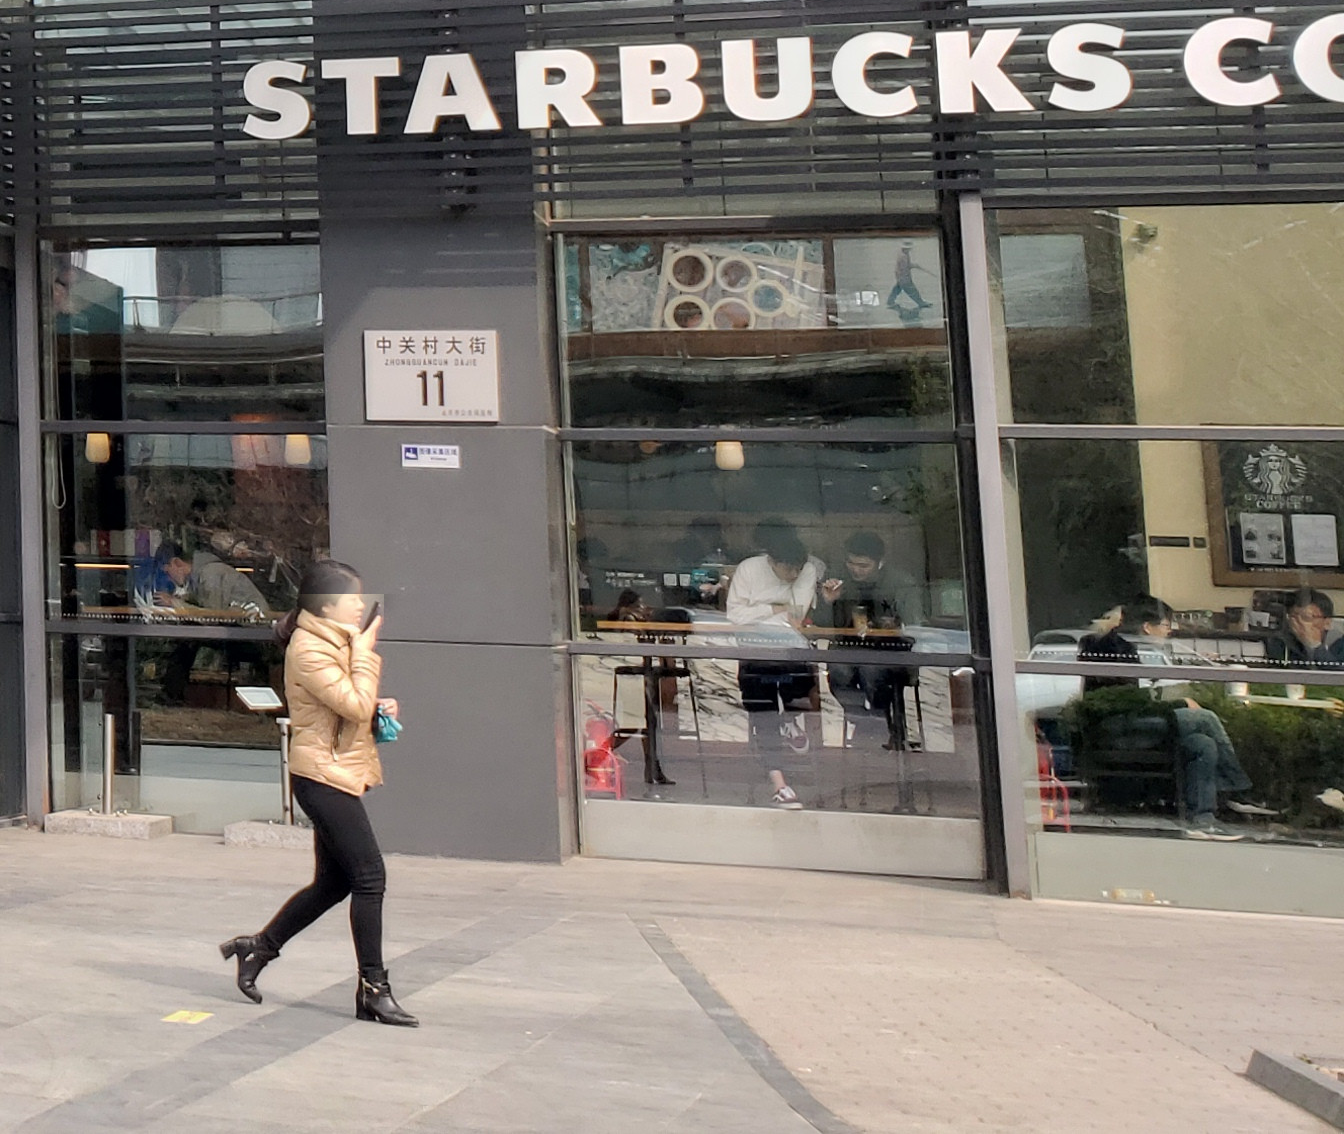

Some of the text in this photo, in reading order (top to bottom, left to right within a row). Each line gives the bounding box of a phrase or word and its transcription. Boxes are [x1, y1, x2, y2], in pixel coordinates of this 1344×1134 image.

[241, 22, 1134, 140] STARBUCKS
[376, 336, 486, 355] 中关村大街
[384, 358, 477, 367] ZHONGGUANCUN DAJIE
[416, 370, 445, 407] 11
